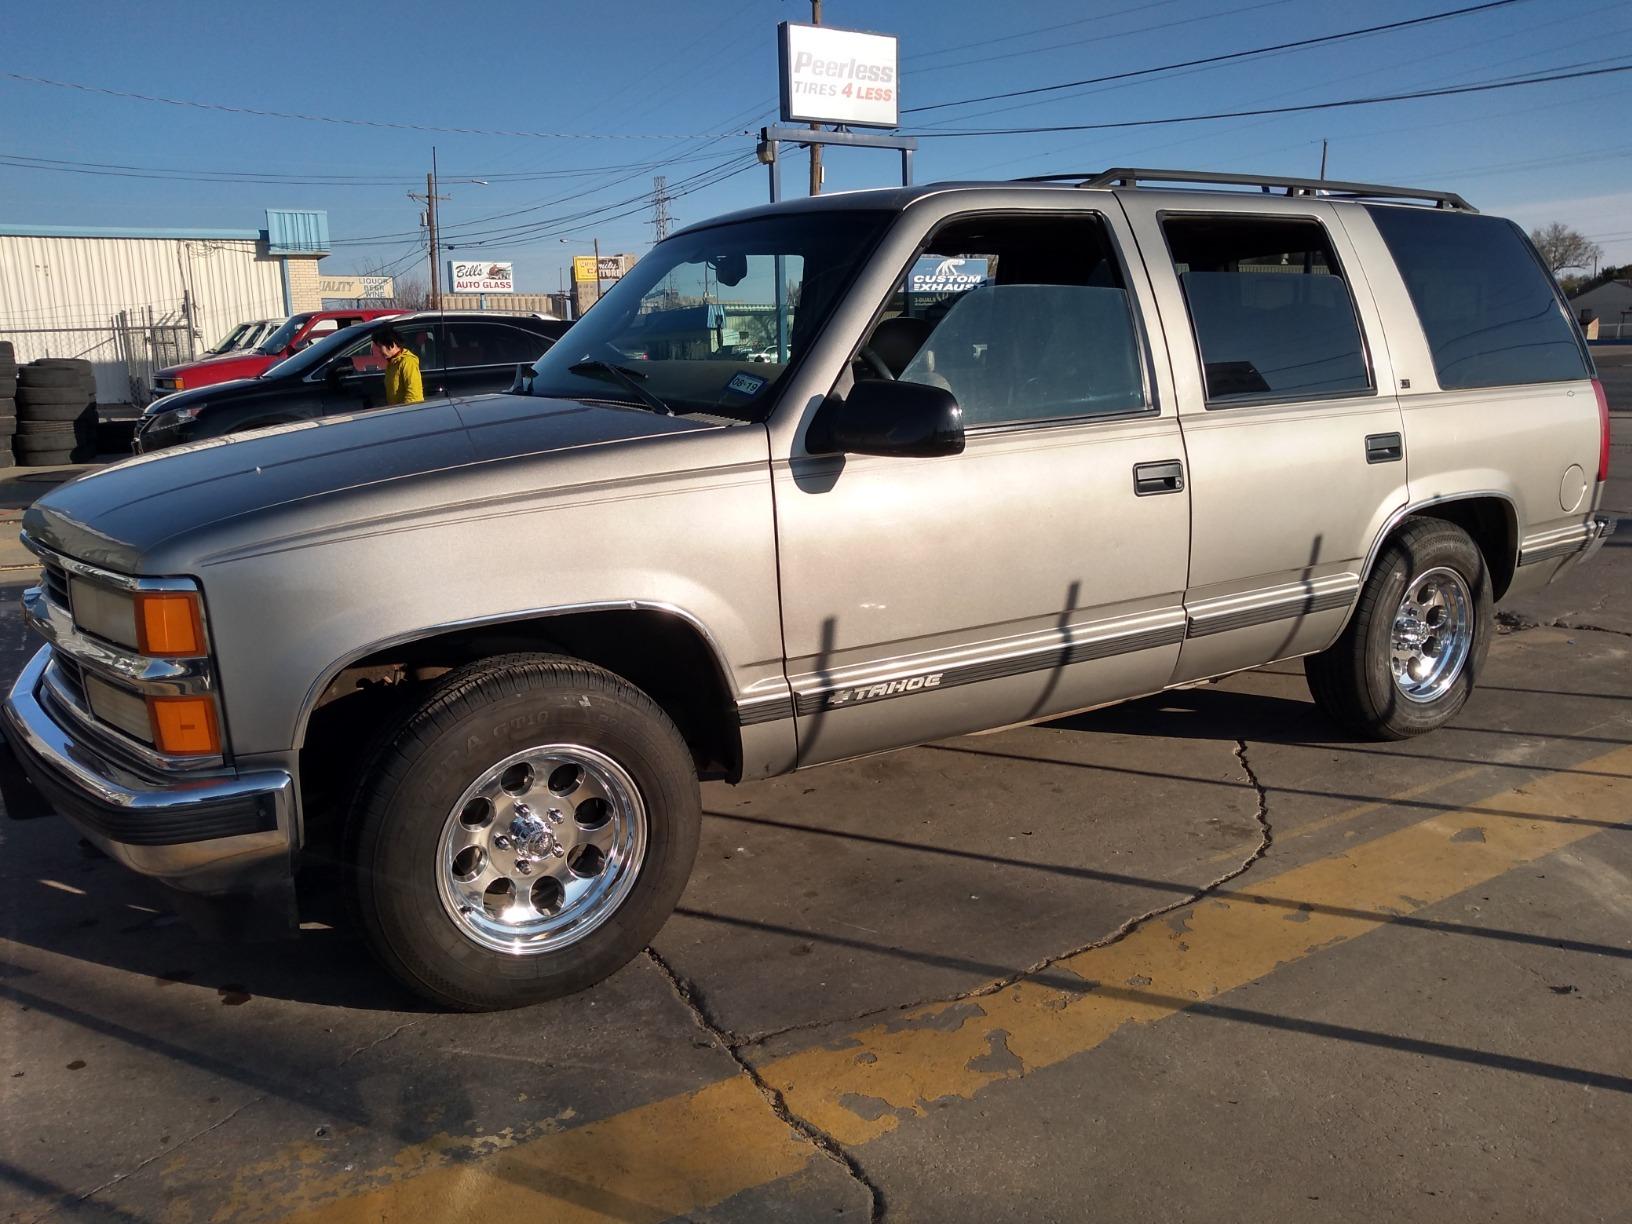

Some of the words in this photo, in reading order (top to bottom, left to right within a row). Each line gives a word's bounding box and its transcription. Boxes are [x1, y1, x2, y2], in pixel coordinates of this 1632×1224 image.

[794, 51, 894, 83] Peerless
[794, 81, 837, 96] TIRES
[841, 82, 853, 98] 4
[856, 86, 893, 102] LESS
[455, 264, 482, 278] Bill's
[320, 280, 355, 292] UALITY
[456, 281, 480, 289] AUTO
[482, 281, 512, 289] GLASS
[913, 275, 981, 283] CUSTOM
[854, 673, 943, 700] TAHOE
